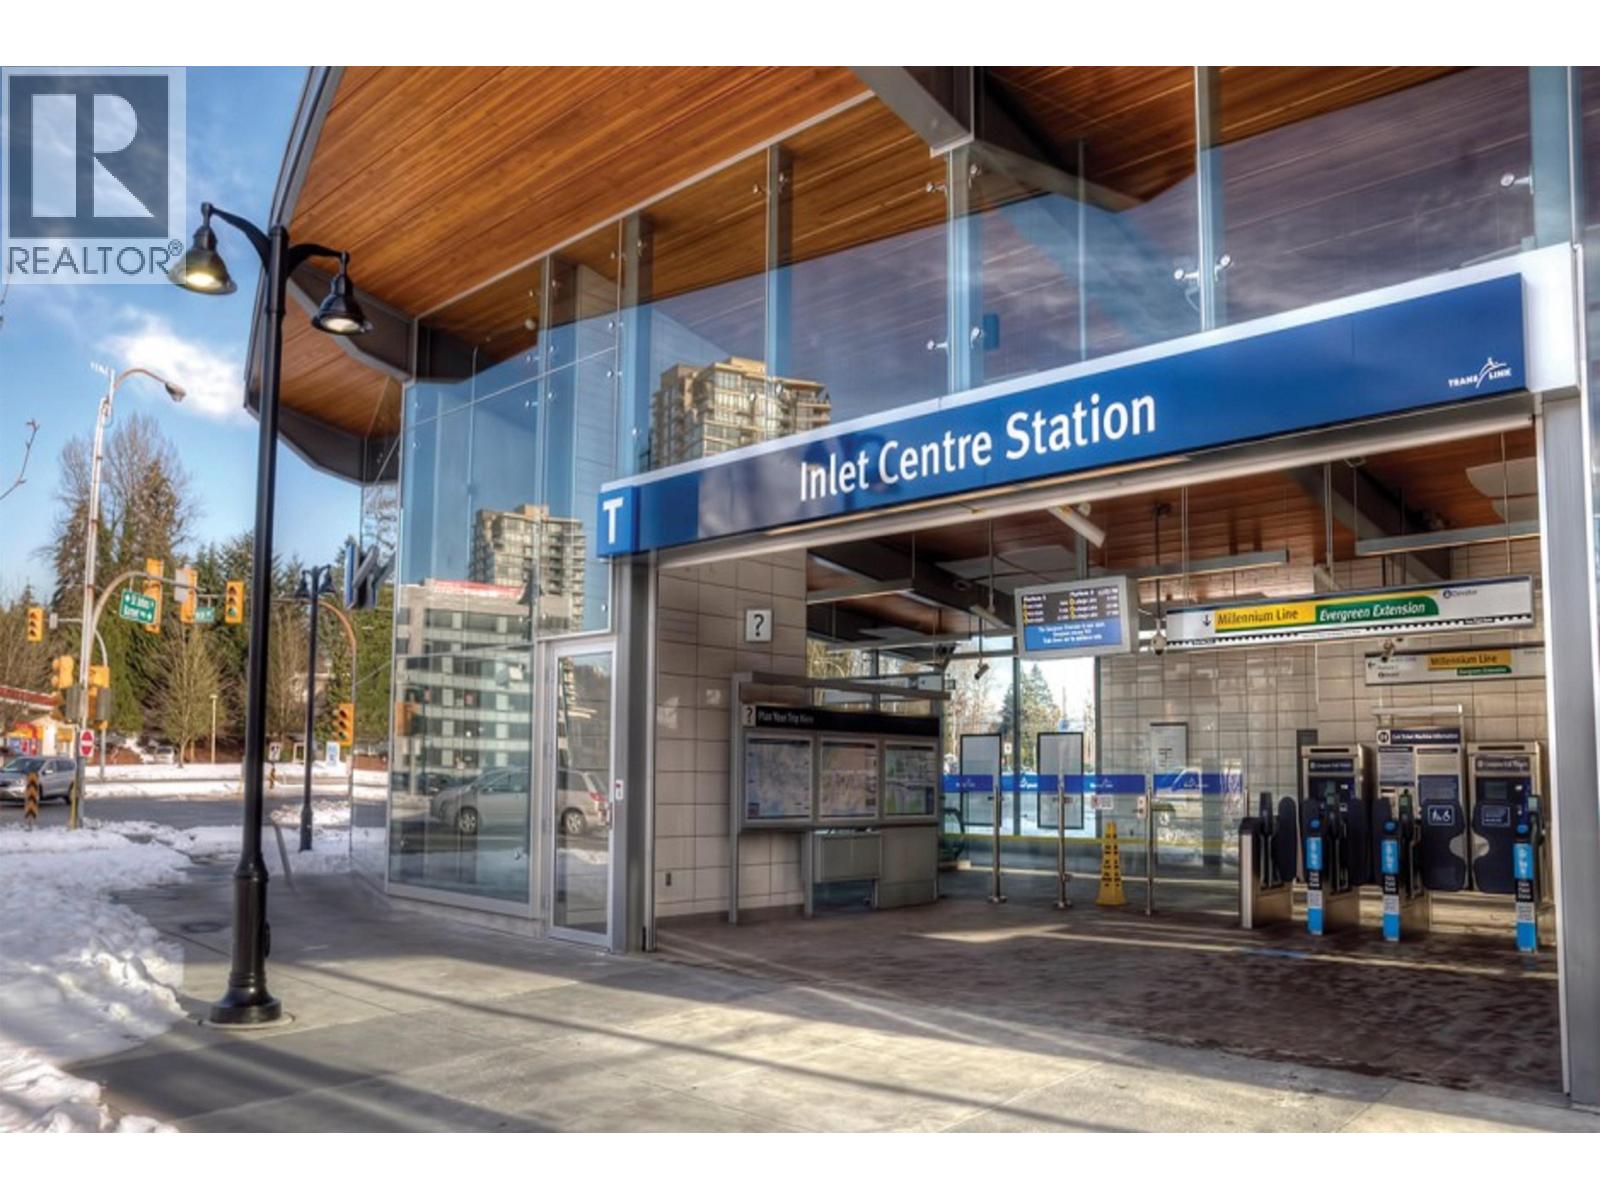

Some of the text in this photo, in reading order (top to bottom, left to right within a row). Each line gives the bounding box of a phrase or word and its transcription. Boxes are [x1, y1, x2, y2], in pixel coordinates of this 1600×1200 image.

[800, 392, 1156, 502] Inlet Centre Station
[602, 496, 624, 545] T
[1217, 607, 1299, 626] Millennium Line
[1319, 601, 1425, 622] Evergreen Extension
[1430, 653, 1498, 667] Millennium Line
